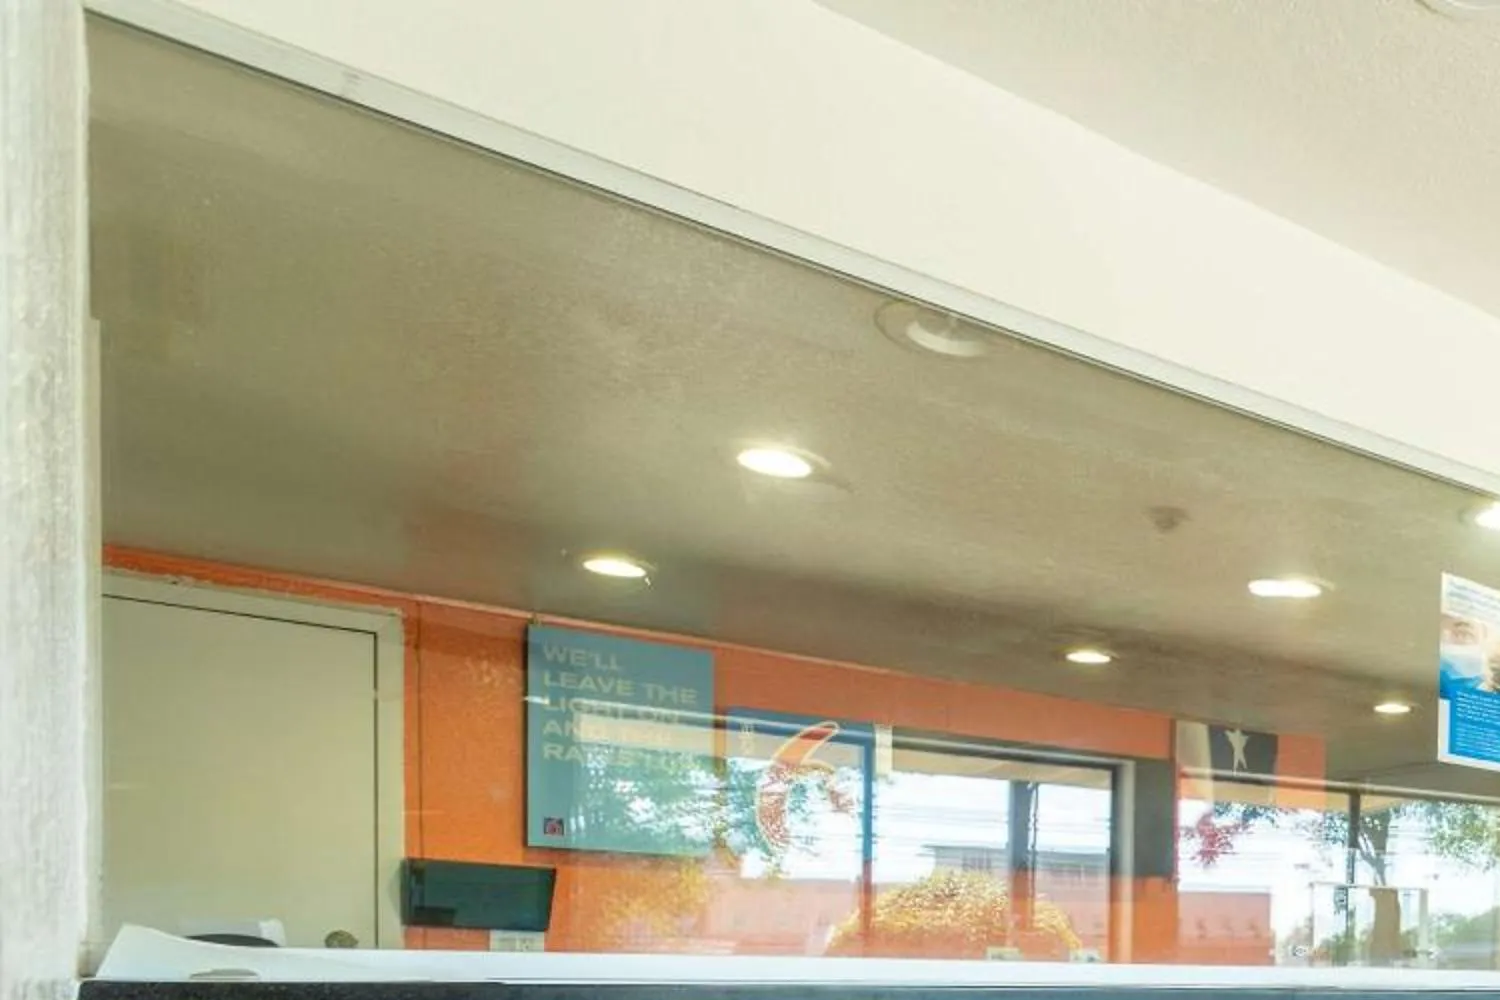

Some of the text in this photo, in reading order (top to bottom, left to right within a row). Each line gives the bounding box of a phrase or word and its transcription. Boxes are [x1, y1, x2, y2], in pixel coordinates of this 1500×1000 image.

[543, 643, 621, 671] WE'LL
[543, 669, 699, 705] LEAVE THE
